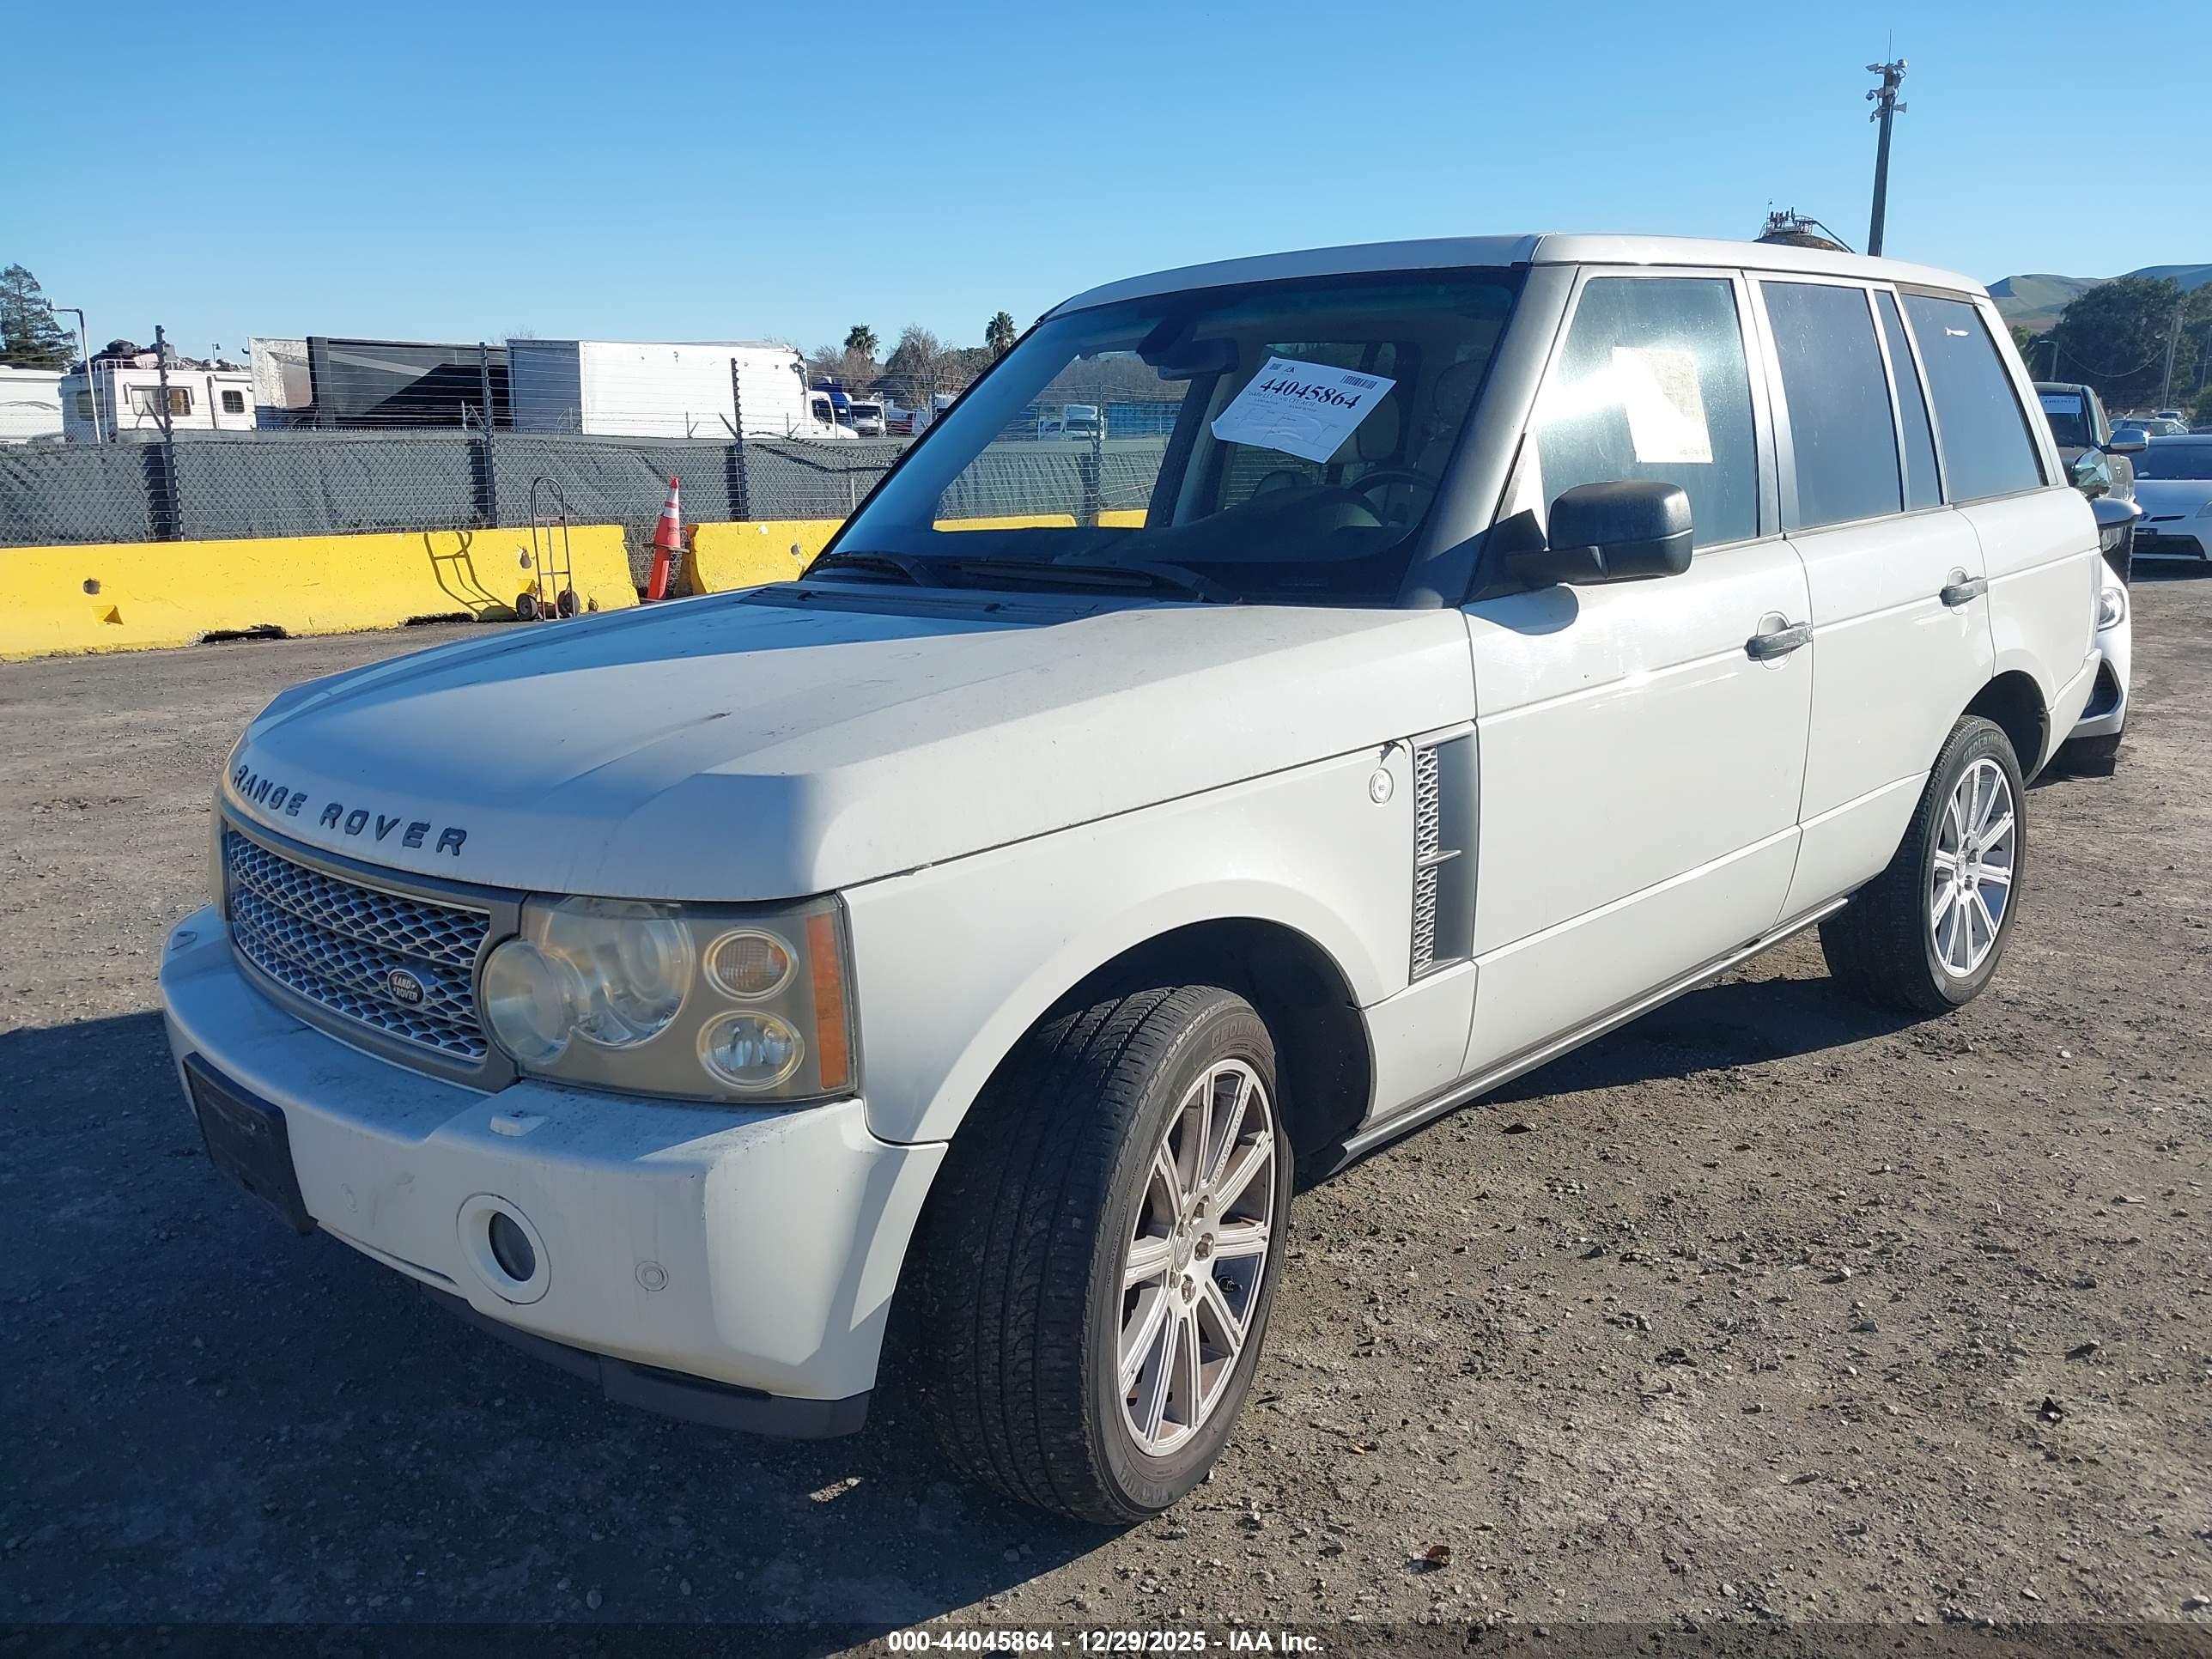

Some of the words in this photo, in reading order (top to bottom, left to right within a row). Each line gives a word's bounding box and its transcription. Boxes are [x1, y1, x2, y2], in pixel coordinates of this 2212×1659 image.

[1260, 377, 1362, 410] 44045864
[233, 764, 307, 817] RANGE
[319, 803, 467, 856] ROVER
[392, 975, 411, 989] LAND
[396, 987, 418, 1002] ROVER
